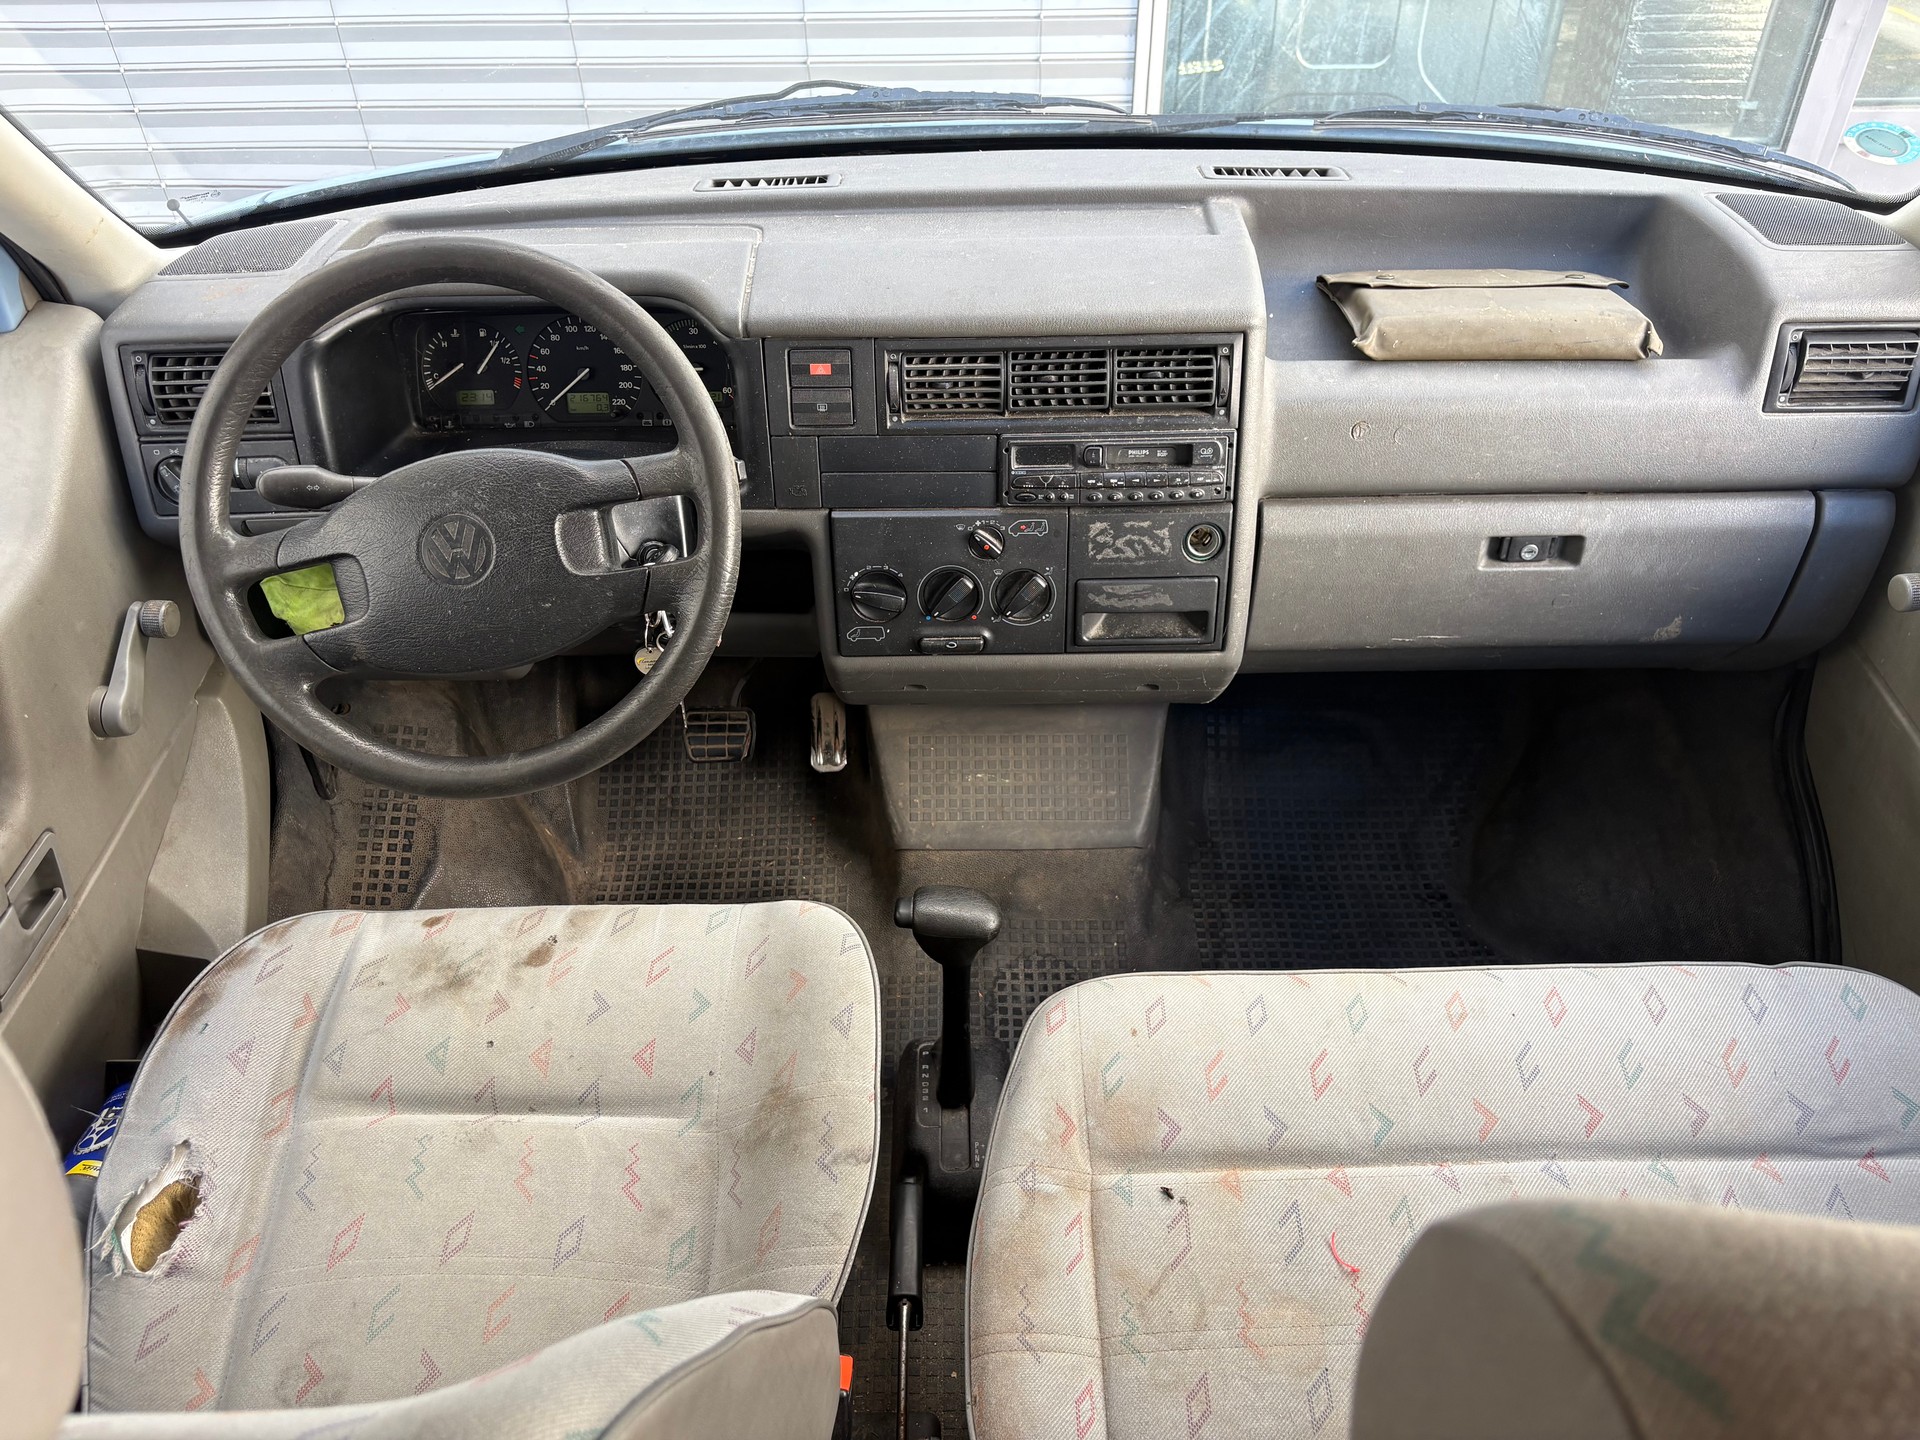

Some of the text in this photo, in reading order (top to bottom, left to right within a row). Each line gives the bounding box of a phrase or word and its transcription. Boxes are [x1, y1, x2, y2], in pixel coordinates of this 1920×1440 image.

[565, 325, 578, 333] 100
[688, 327, 699, 335] 30
[500, 357, 511, 365] 1/2
[620, 364, 633, 372] 180
[618, 381, 633, 389] 200
[722, 386, 733, 394] 60
